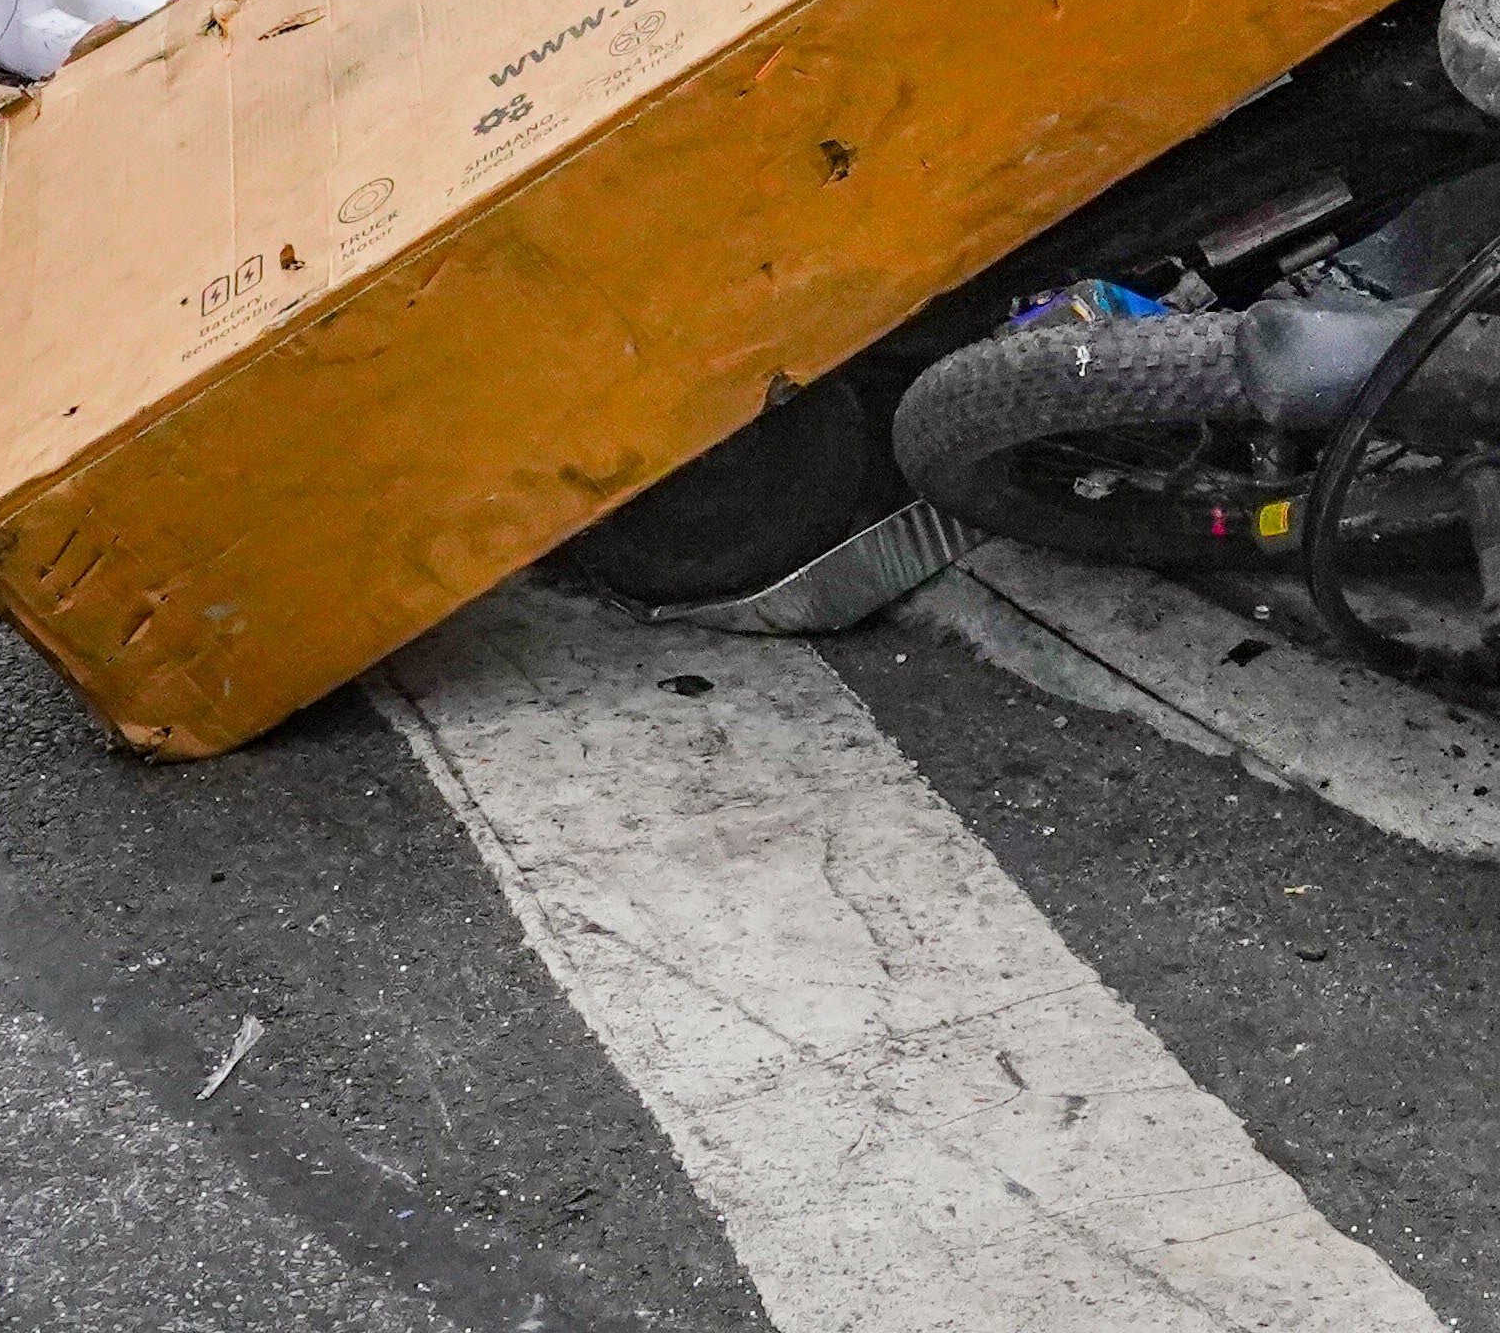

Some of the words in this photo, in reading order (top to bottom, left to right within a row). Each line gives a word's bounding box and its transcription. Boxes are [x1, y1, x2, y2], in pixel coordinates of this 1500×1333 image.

[463, 112, 555, 175] SHIMANO
[338, 209, 401, 251] TRUCK
[341, 224, 397, 264] Motor
[180, 296, 283, 363] Removable
[198, 293, 265, 339] Battery
